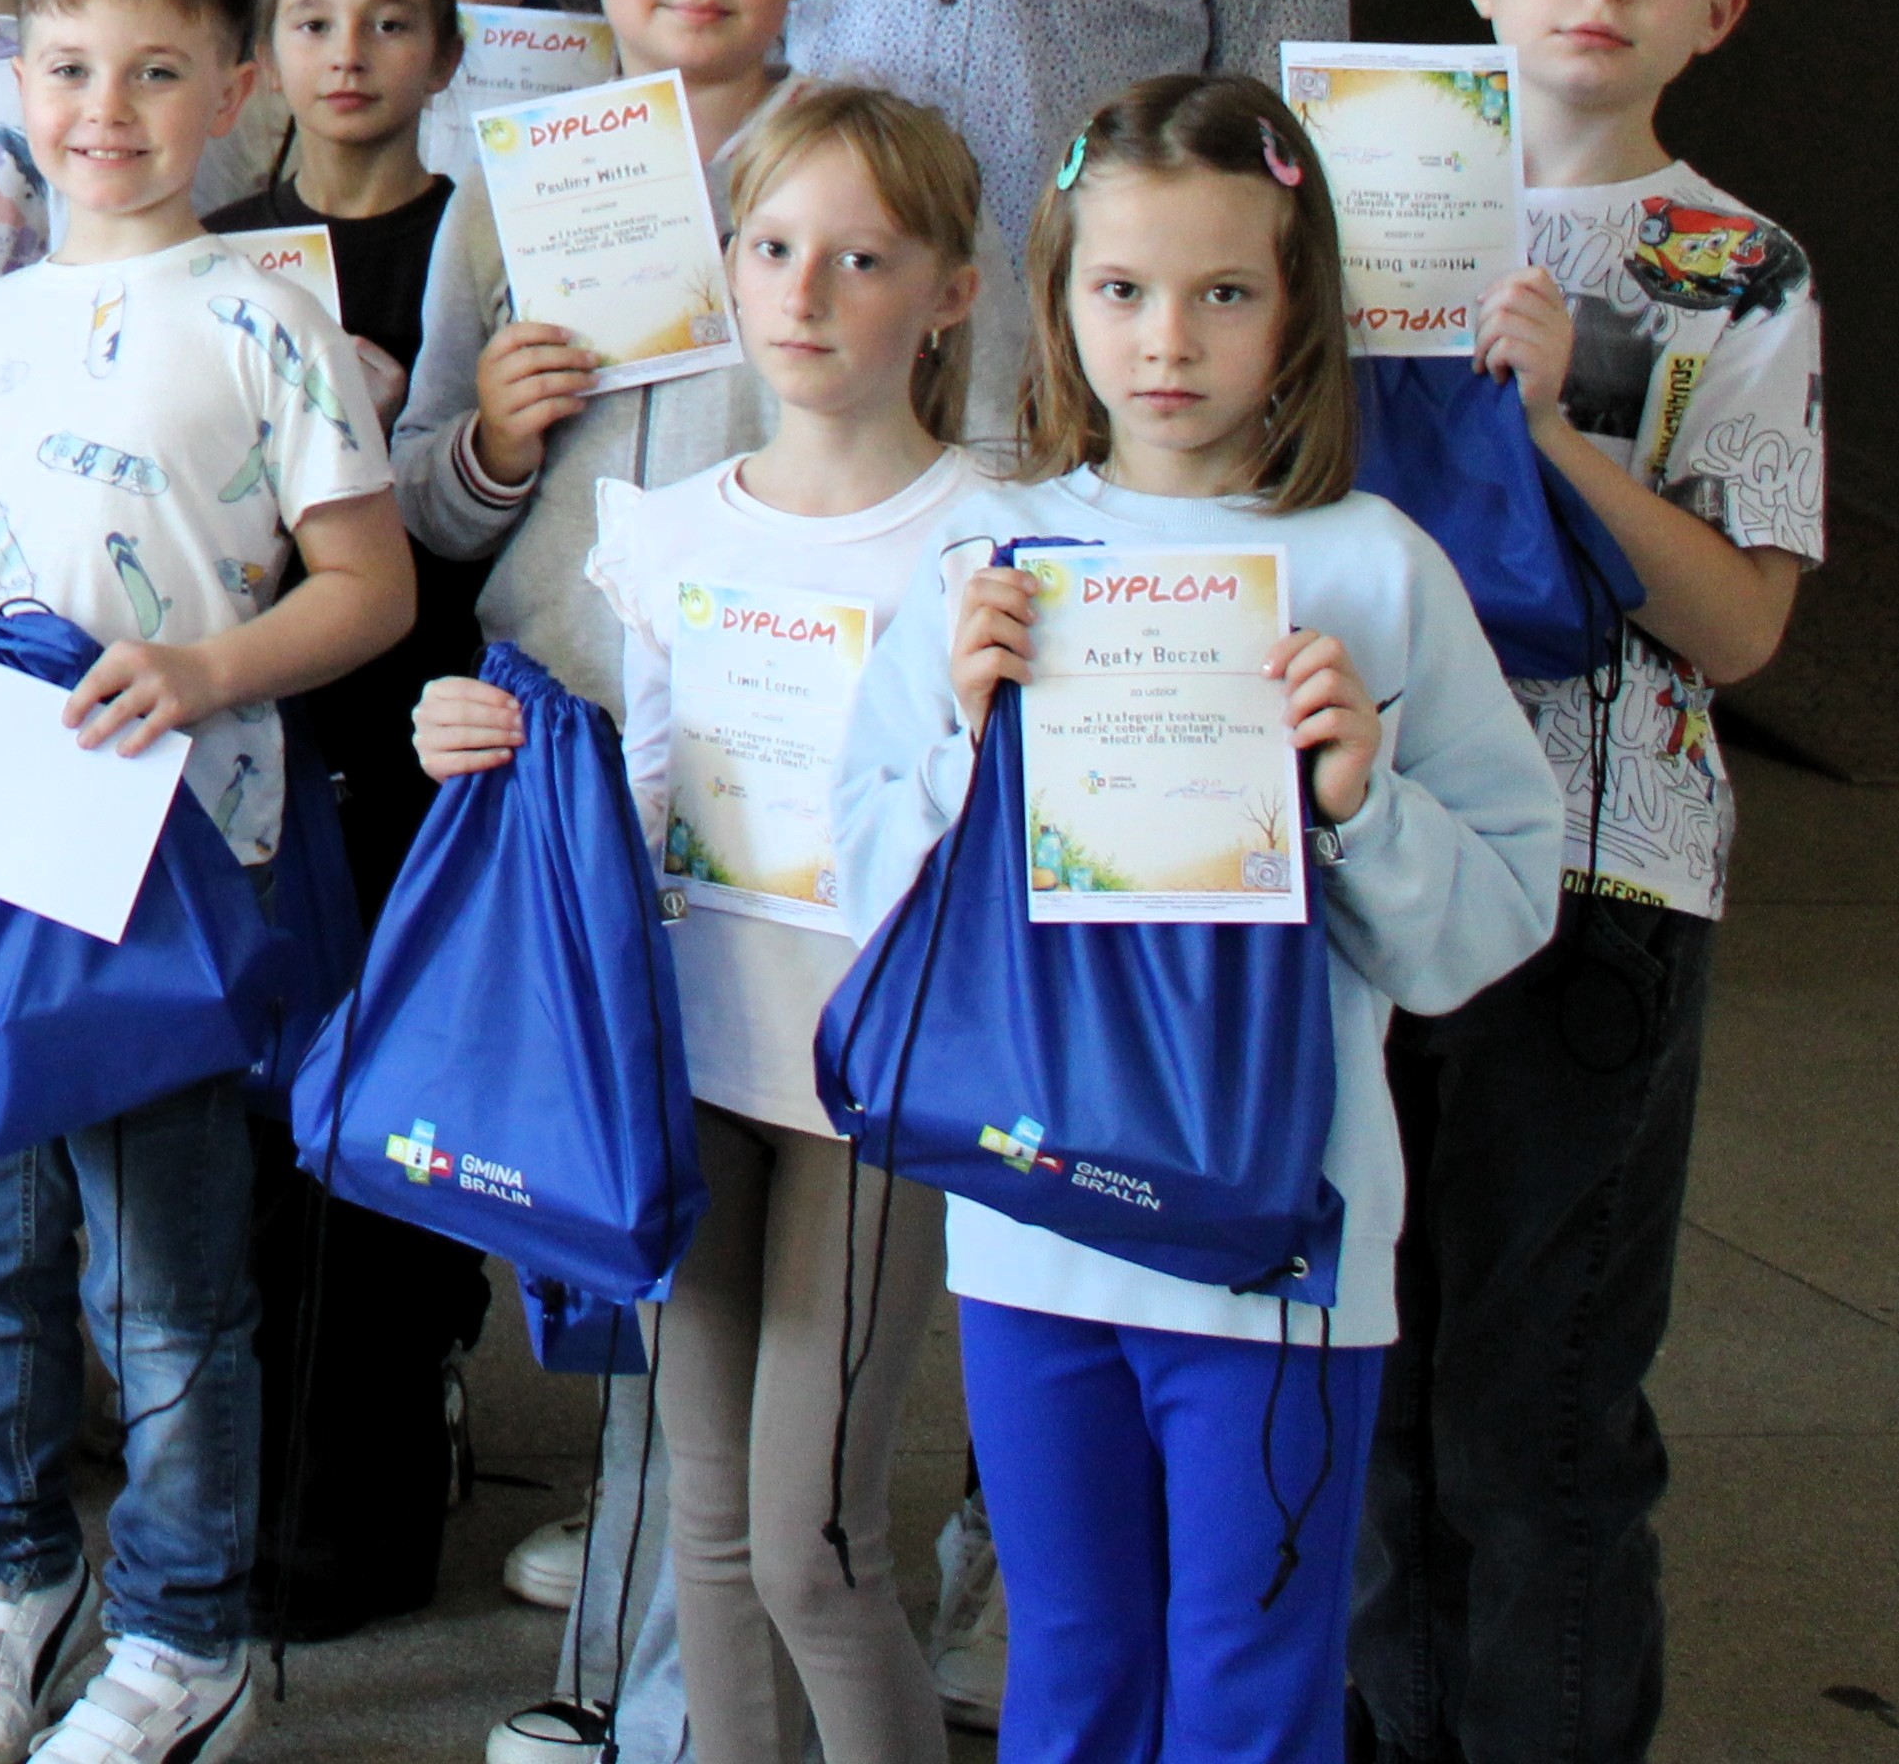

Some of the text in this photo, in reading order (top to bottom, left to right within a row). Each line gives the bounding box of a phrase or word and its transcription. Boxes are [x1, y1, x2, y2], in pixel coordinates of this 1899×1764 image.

[484, 28, 586, 52] DYPLOM
[529, 102, 648, 147] DYPLOM
[536, 177, 590, 196] Pauliny
[1083, 574, 1237, 604] DYPLOM
[723, 606, 836, 645] DYPLOM
[1084, 646, 1220, 667] Agaty Boczek
[461, 1153, 523, 1190] GMINA
[1075, 1161, 1153, 1196] GMINA
[459, 1172, 533, 1207] BRALIN
[1071, 1173, 1161, 1211] BRALIN
